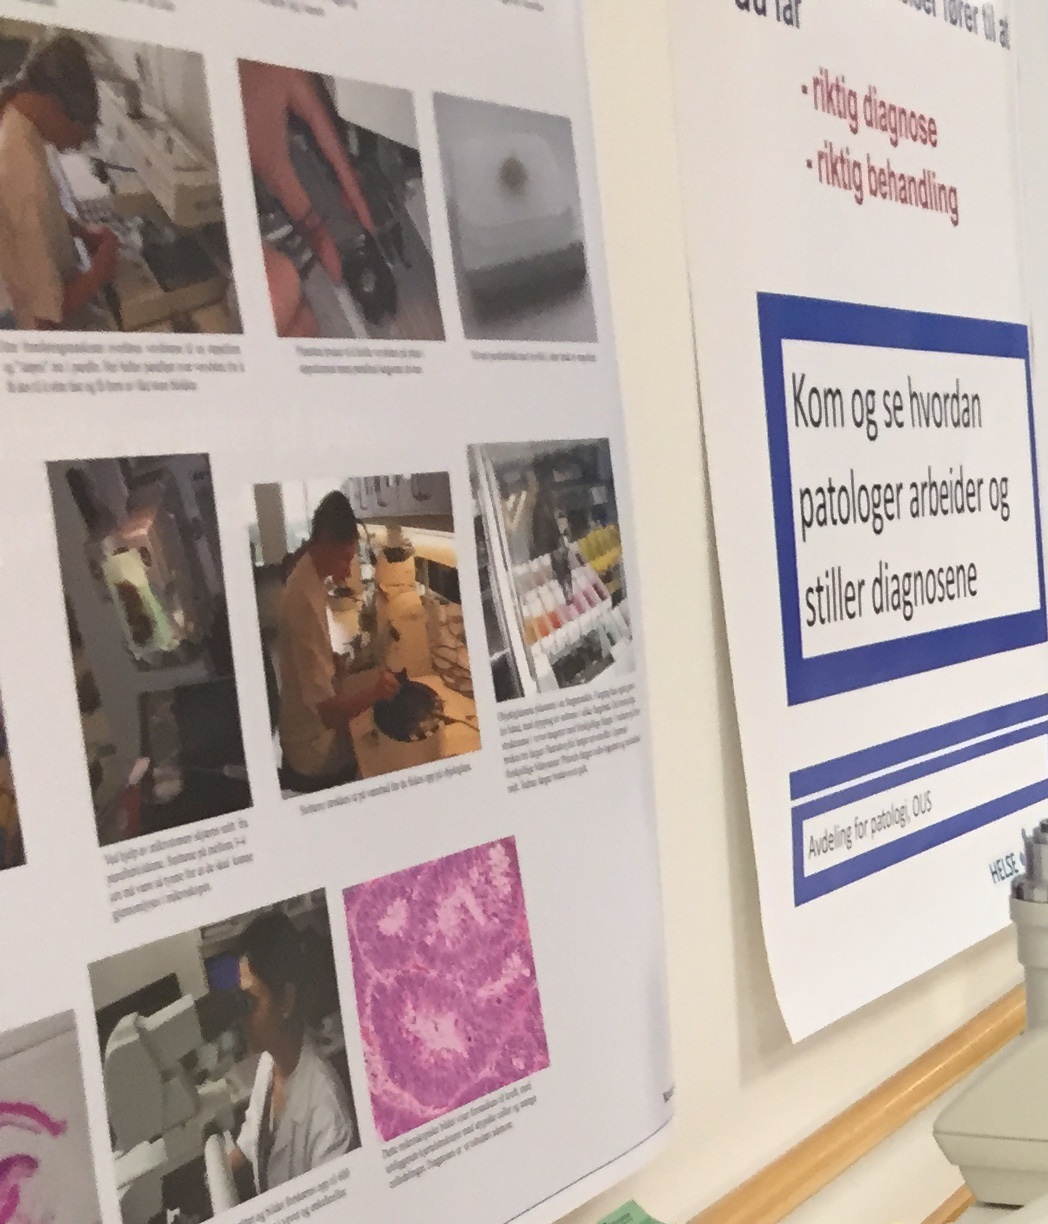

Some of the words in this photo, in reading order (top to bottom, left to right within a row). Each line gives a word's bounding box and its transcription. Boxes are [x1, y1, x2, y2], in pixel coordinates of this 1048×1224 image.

[813, 65, 858, 135] riktig
[863, 85, 937, 147] diagnose
[817, 140, 863, 205] riktig
[867, 153, 959, 227] behandling
[792, 372, 845, 428] Kom
[851, 387, 878, 441] og
[883, 388, 904, 429] se
[908, 375, 982, 428] hvordan
[799, 468, 903, 542] patologer
[909, 465, 983, 518] arbeider
[989, 476, 1010, 521] og
[805, 565, 866, 627] stiller
[871, 560, 978, 621] diagnosene
[808, 825, 852, 859] Avdeling
[854, 816, 867, 841] for
[912, 790, 932, 817] OUS
[989, 853, 1018, 883] HELSE
